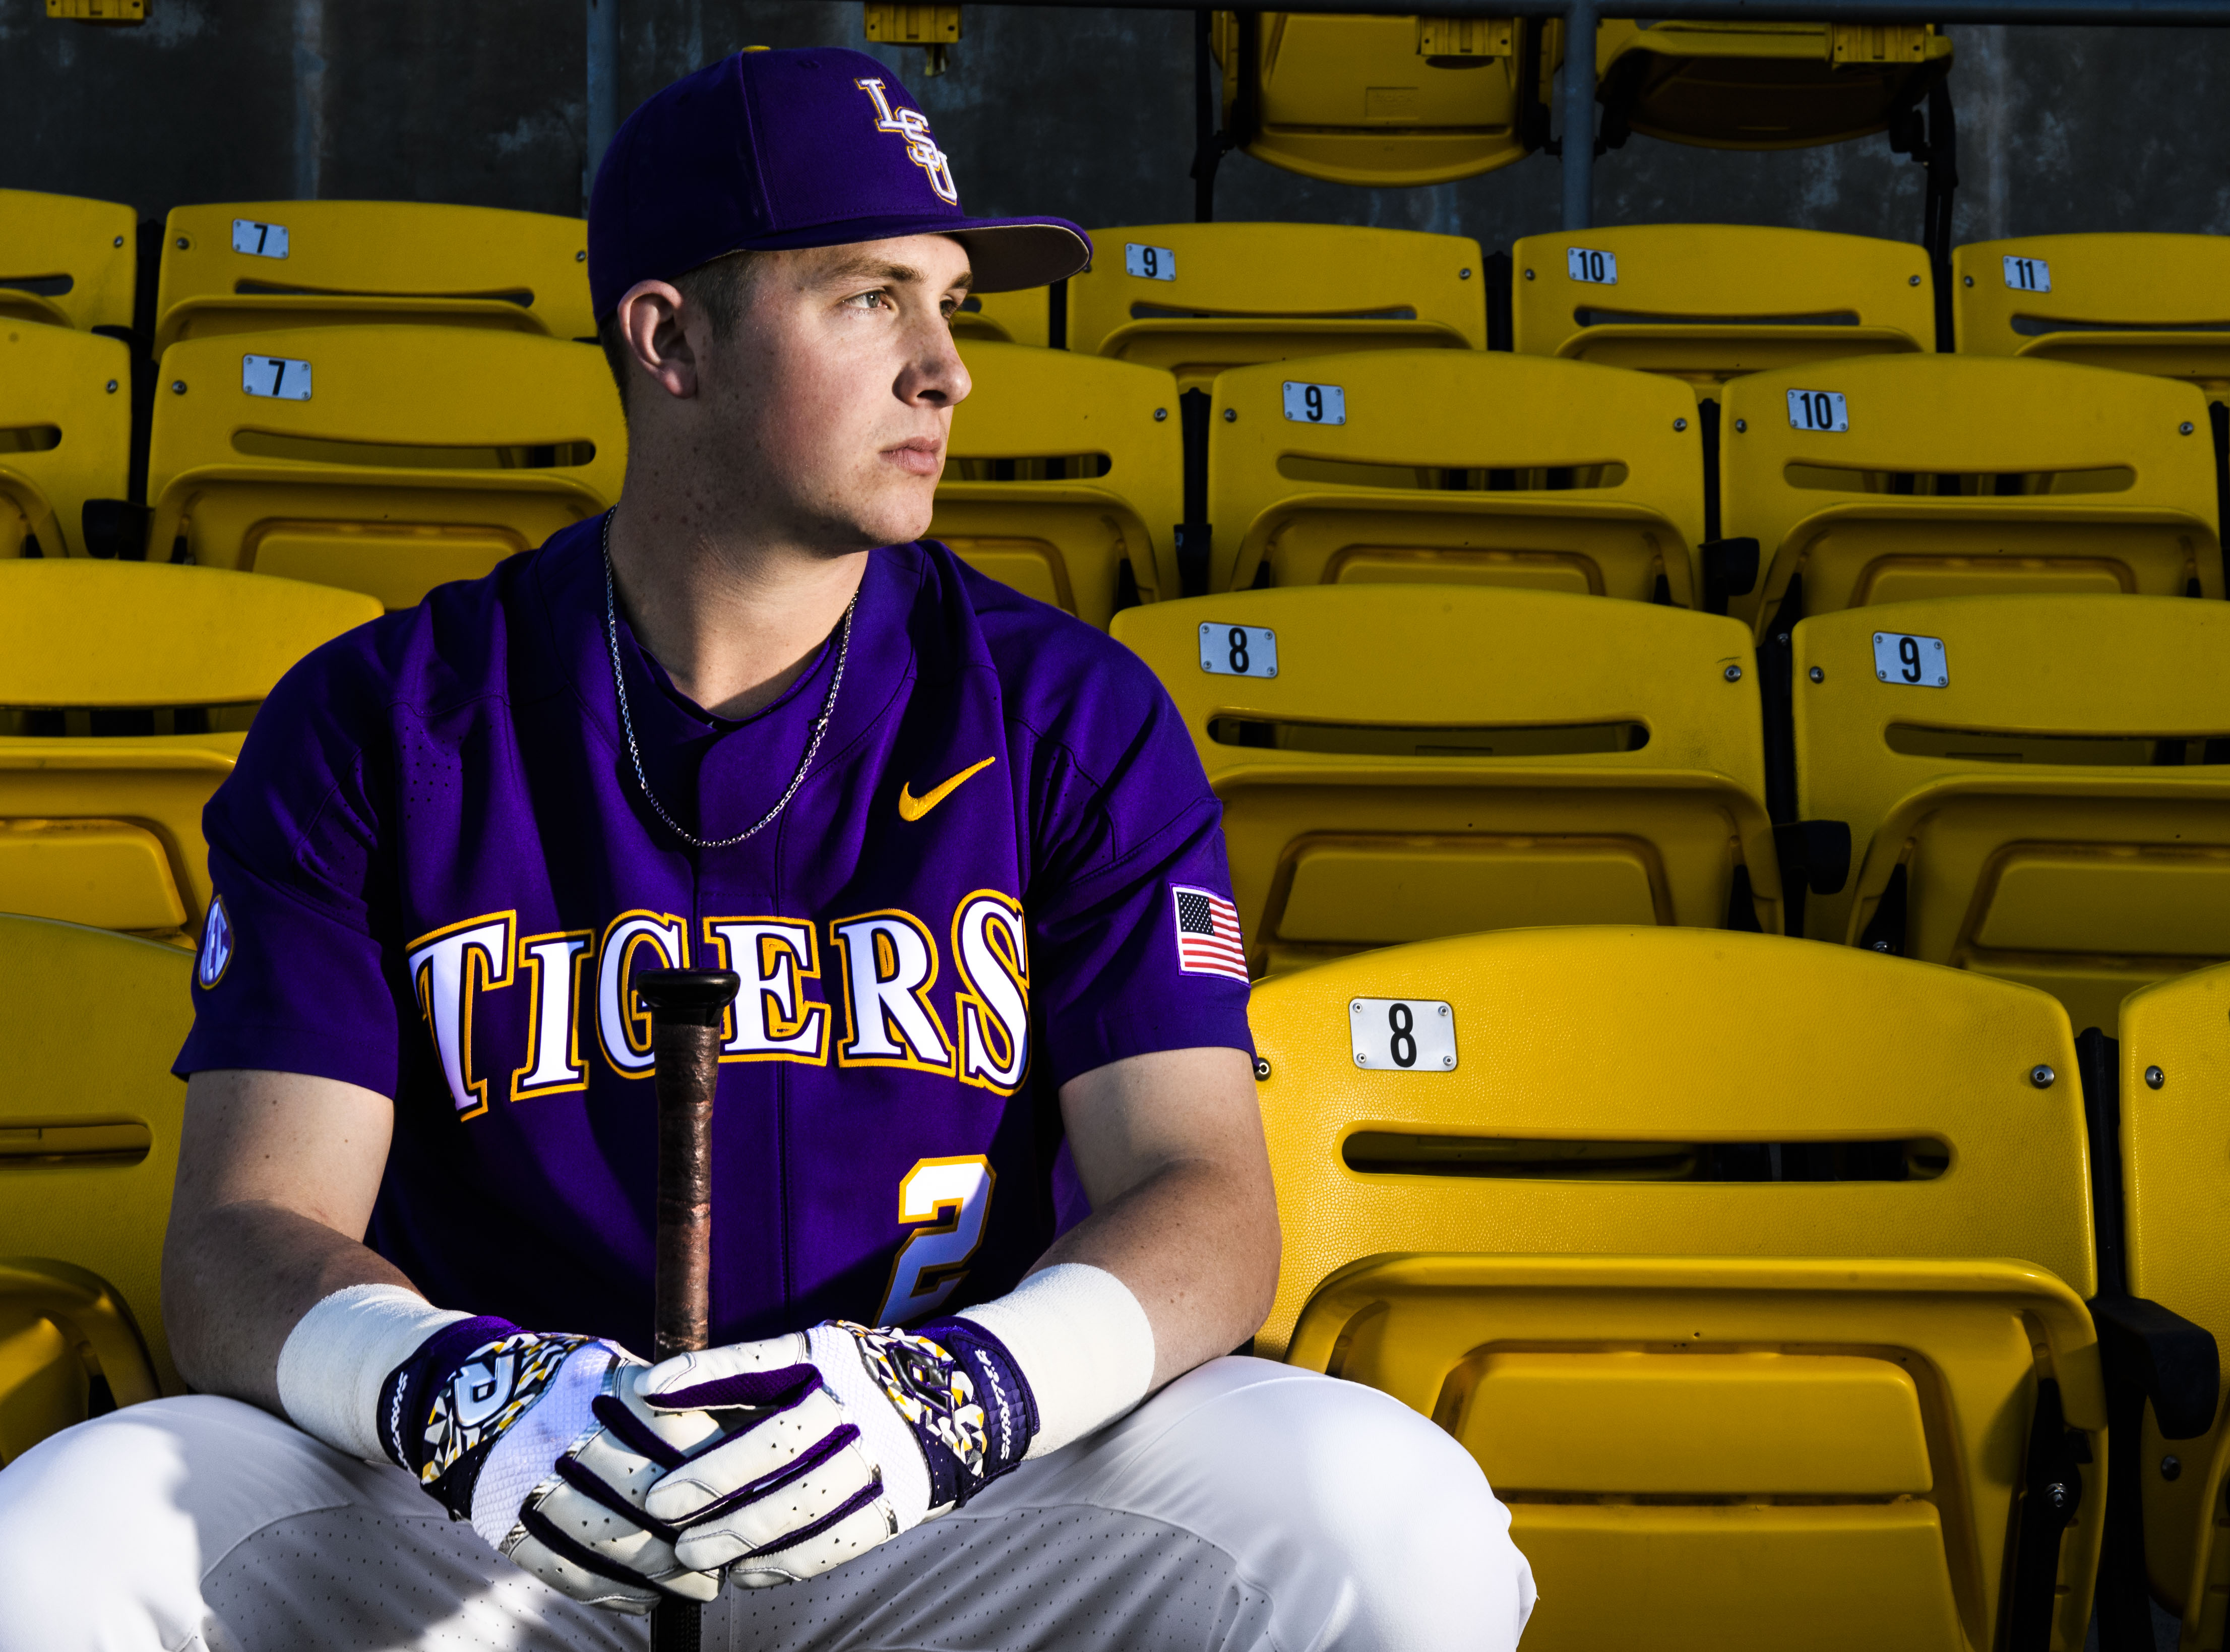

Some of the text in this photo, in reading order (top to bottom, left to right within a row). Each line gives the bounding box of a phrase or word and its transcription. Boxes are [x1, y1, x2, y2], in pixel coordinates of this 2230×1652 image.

[854, 77, 957, 206] LSU
[254, 222, 268, 255] 7
[1143, 247, 1158, 277] 9
[1578, 251, 1604, 281] 10
[2015, 259, 2035, 289] 11
[268, 359, 286, 397] 7
[1304, 385, 1323, 421] 9
[1800, 392, 1833, 430] 10
[1228, 627, 1250, 674] 8
[1899, 636, 1922, 683] 9
[405, 888, 1032, 1123] TIGERS
[1389, 1003, 1417, 1068] 8
[871, 1153, 997, 1329] 2
